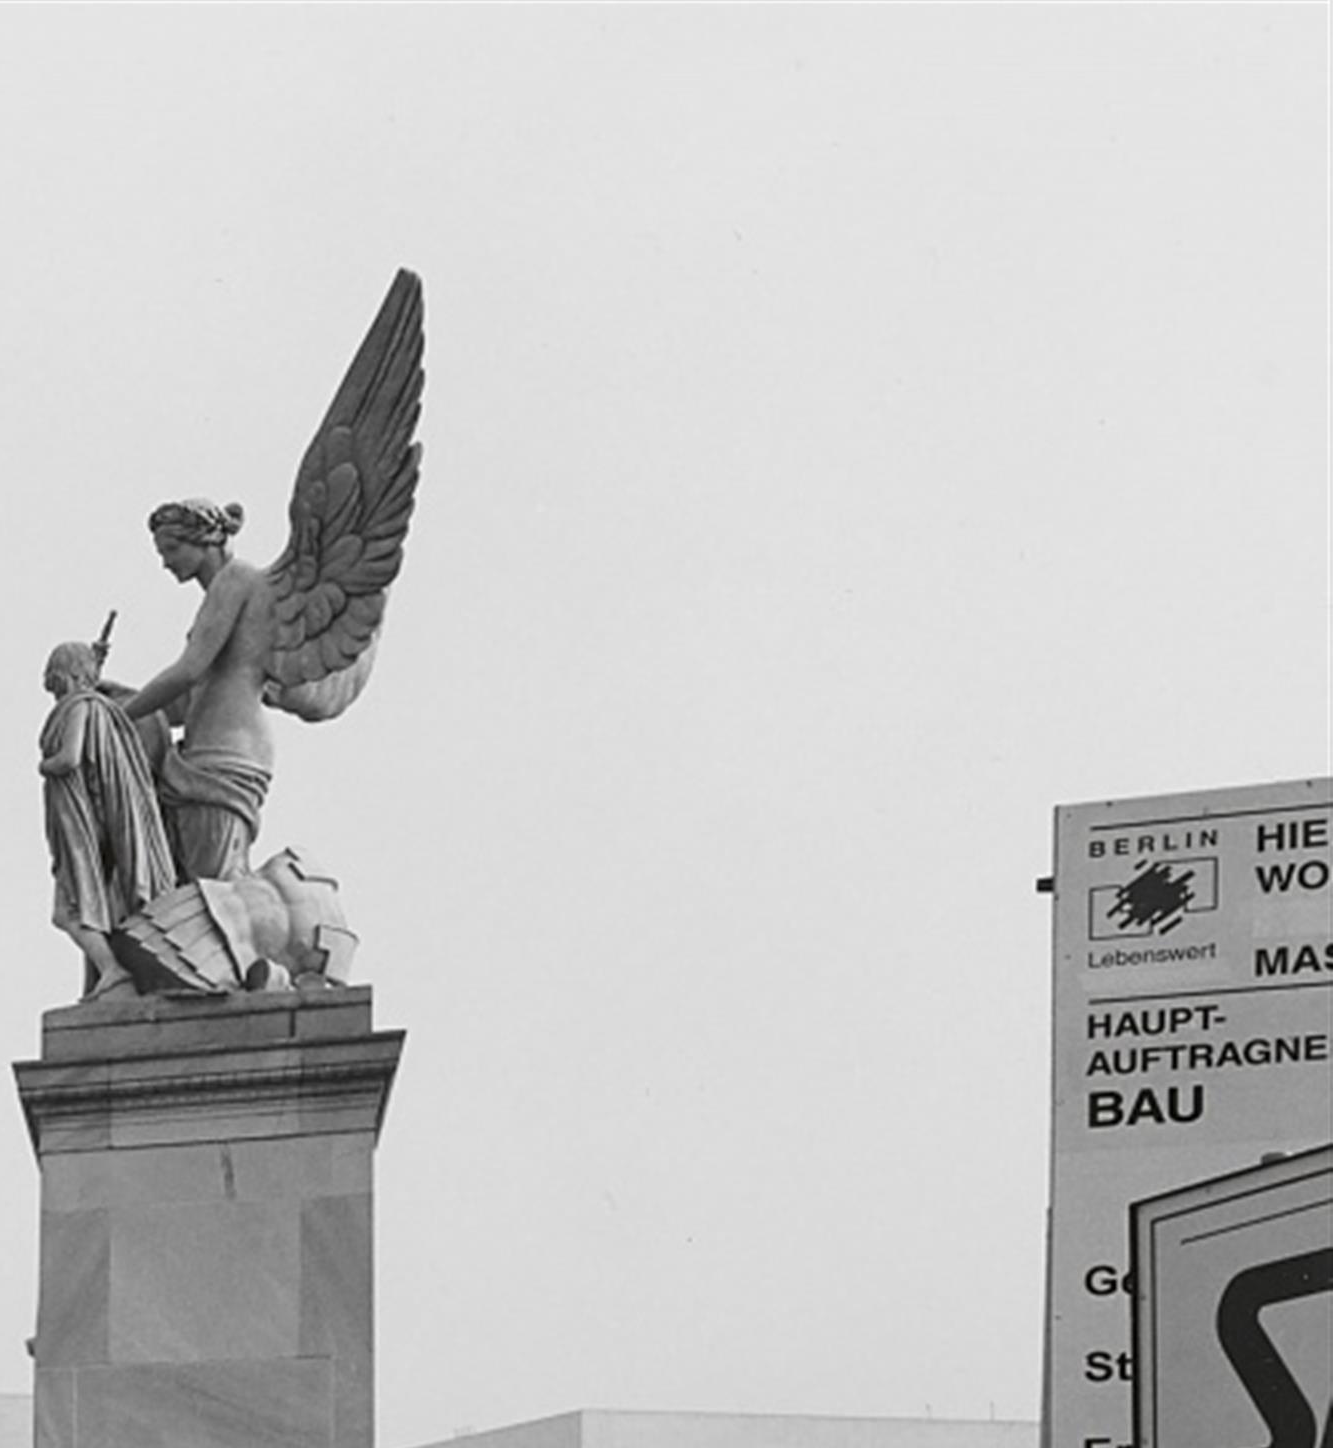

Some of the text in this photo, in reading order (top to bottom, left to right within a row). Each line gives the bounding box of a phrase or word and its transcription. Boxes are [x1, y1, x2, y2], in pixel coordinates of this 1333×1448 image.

[1089, 829, 1219, 858] BERLIN
[1257, 819, 1328, 853] HIE
[1255, 860, 1329, 894] WO
[1088, 943, 1217, 969] Lebenswert
[1088, 1005, 1226, 1039] HAUPT-
[1086, 1034, 1328, 1077] AUFTRAGNE
[1089, 1085, 1204, 1129] BAU
